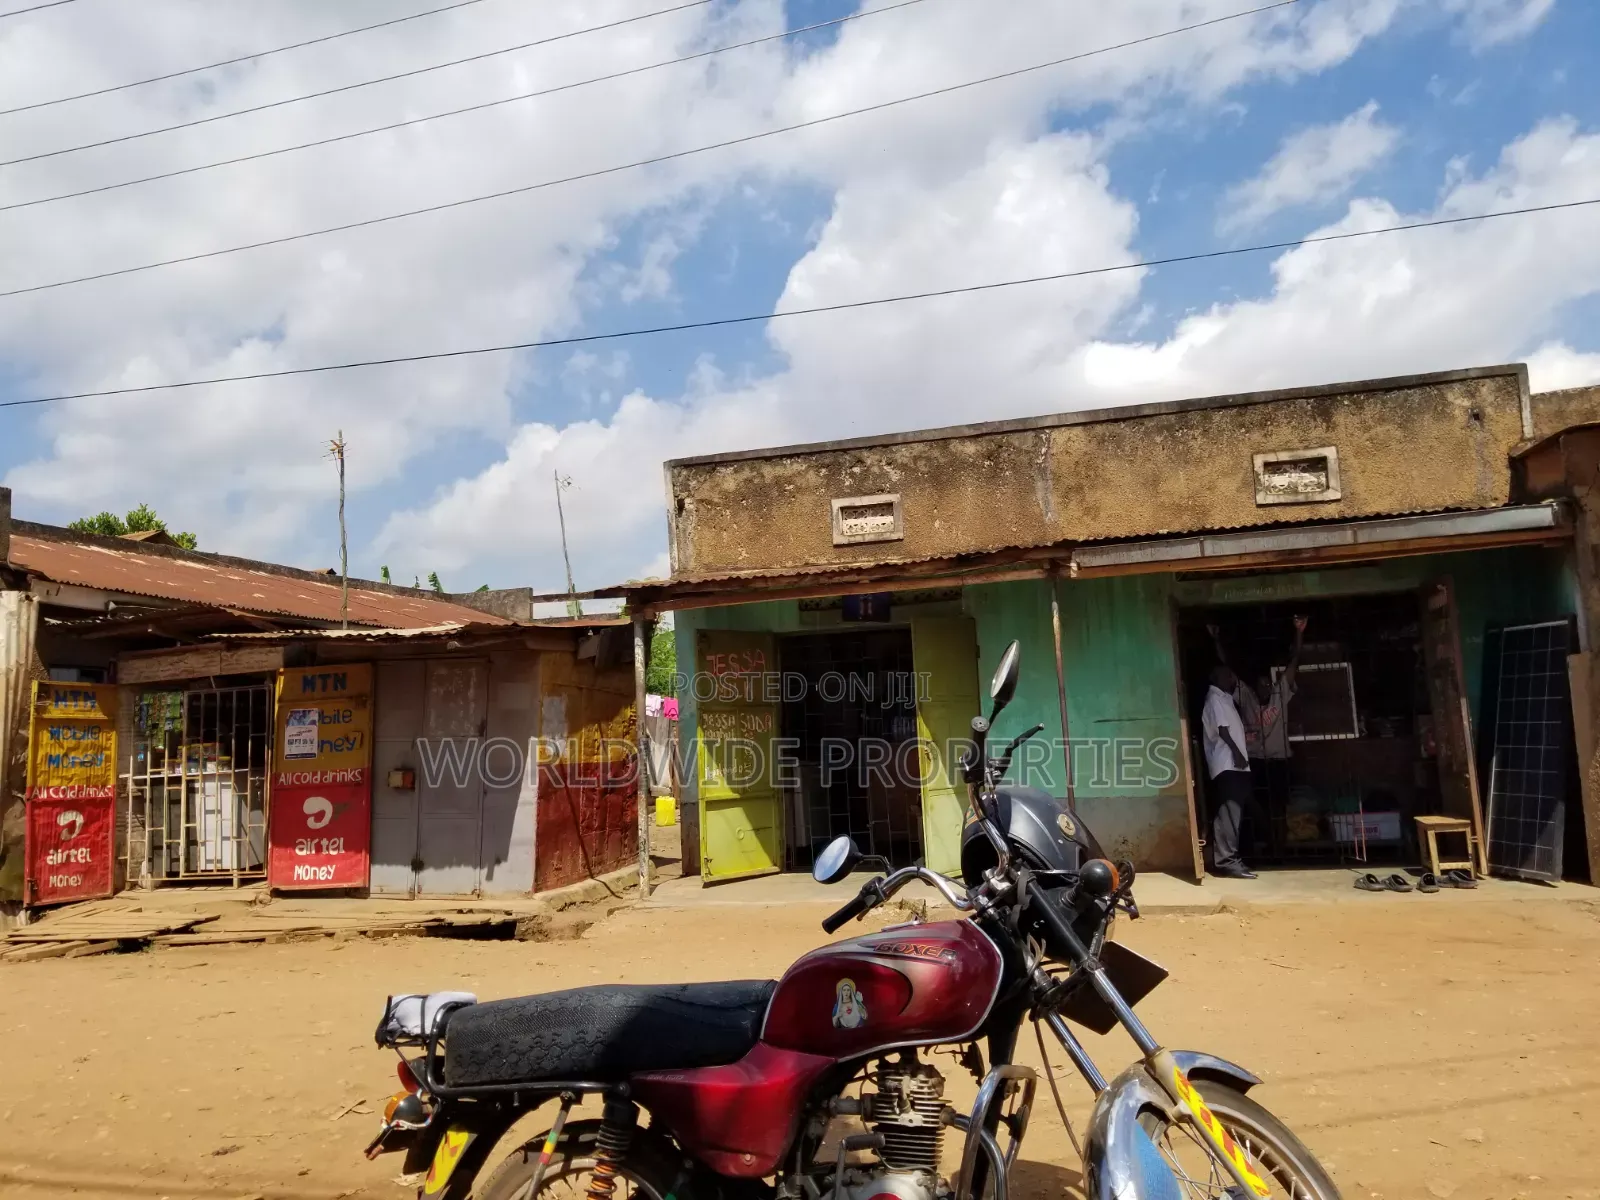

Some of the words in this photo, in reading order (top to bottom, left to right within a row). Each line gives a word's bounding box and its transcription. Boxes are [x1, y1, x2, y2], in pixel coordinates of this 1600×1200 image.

[706, 649, 766, 676] JESSA
[302, 672, 347, 693] MTN
[53, 690, 97, 709] MTN
[317, 709, 353, 724] bile
[317, 735, 357, 753] ney
[279, 772, 292, 785] All
[322, 768, 362, 783] drinks
[31, 786, 48, 799] All
[79, 785, 113, 799] drinks
[295, 837, 346, 856] airtel
[46, 847, 92, 865] airtel
[874, 941, 957, 961] BOXER
